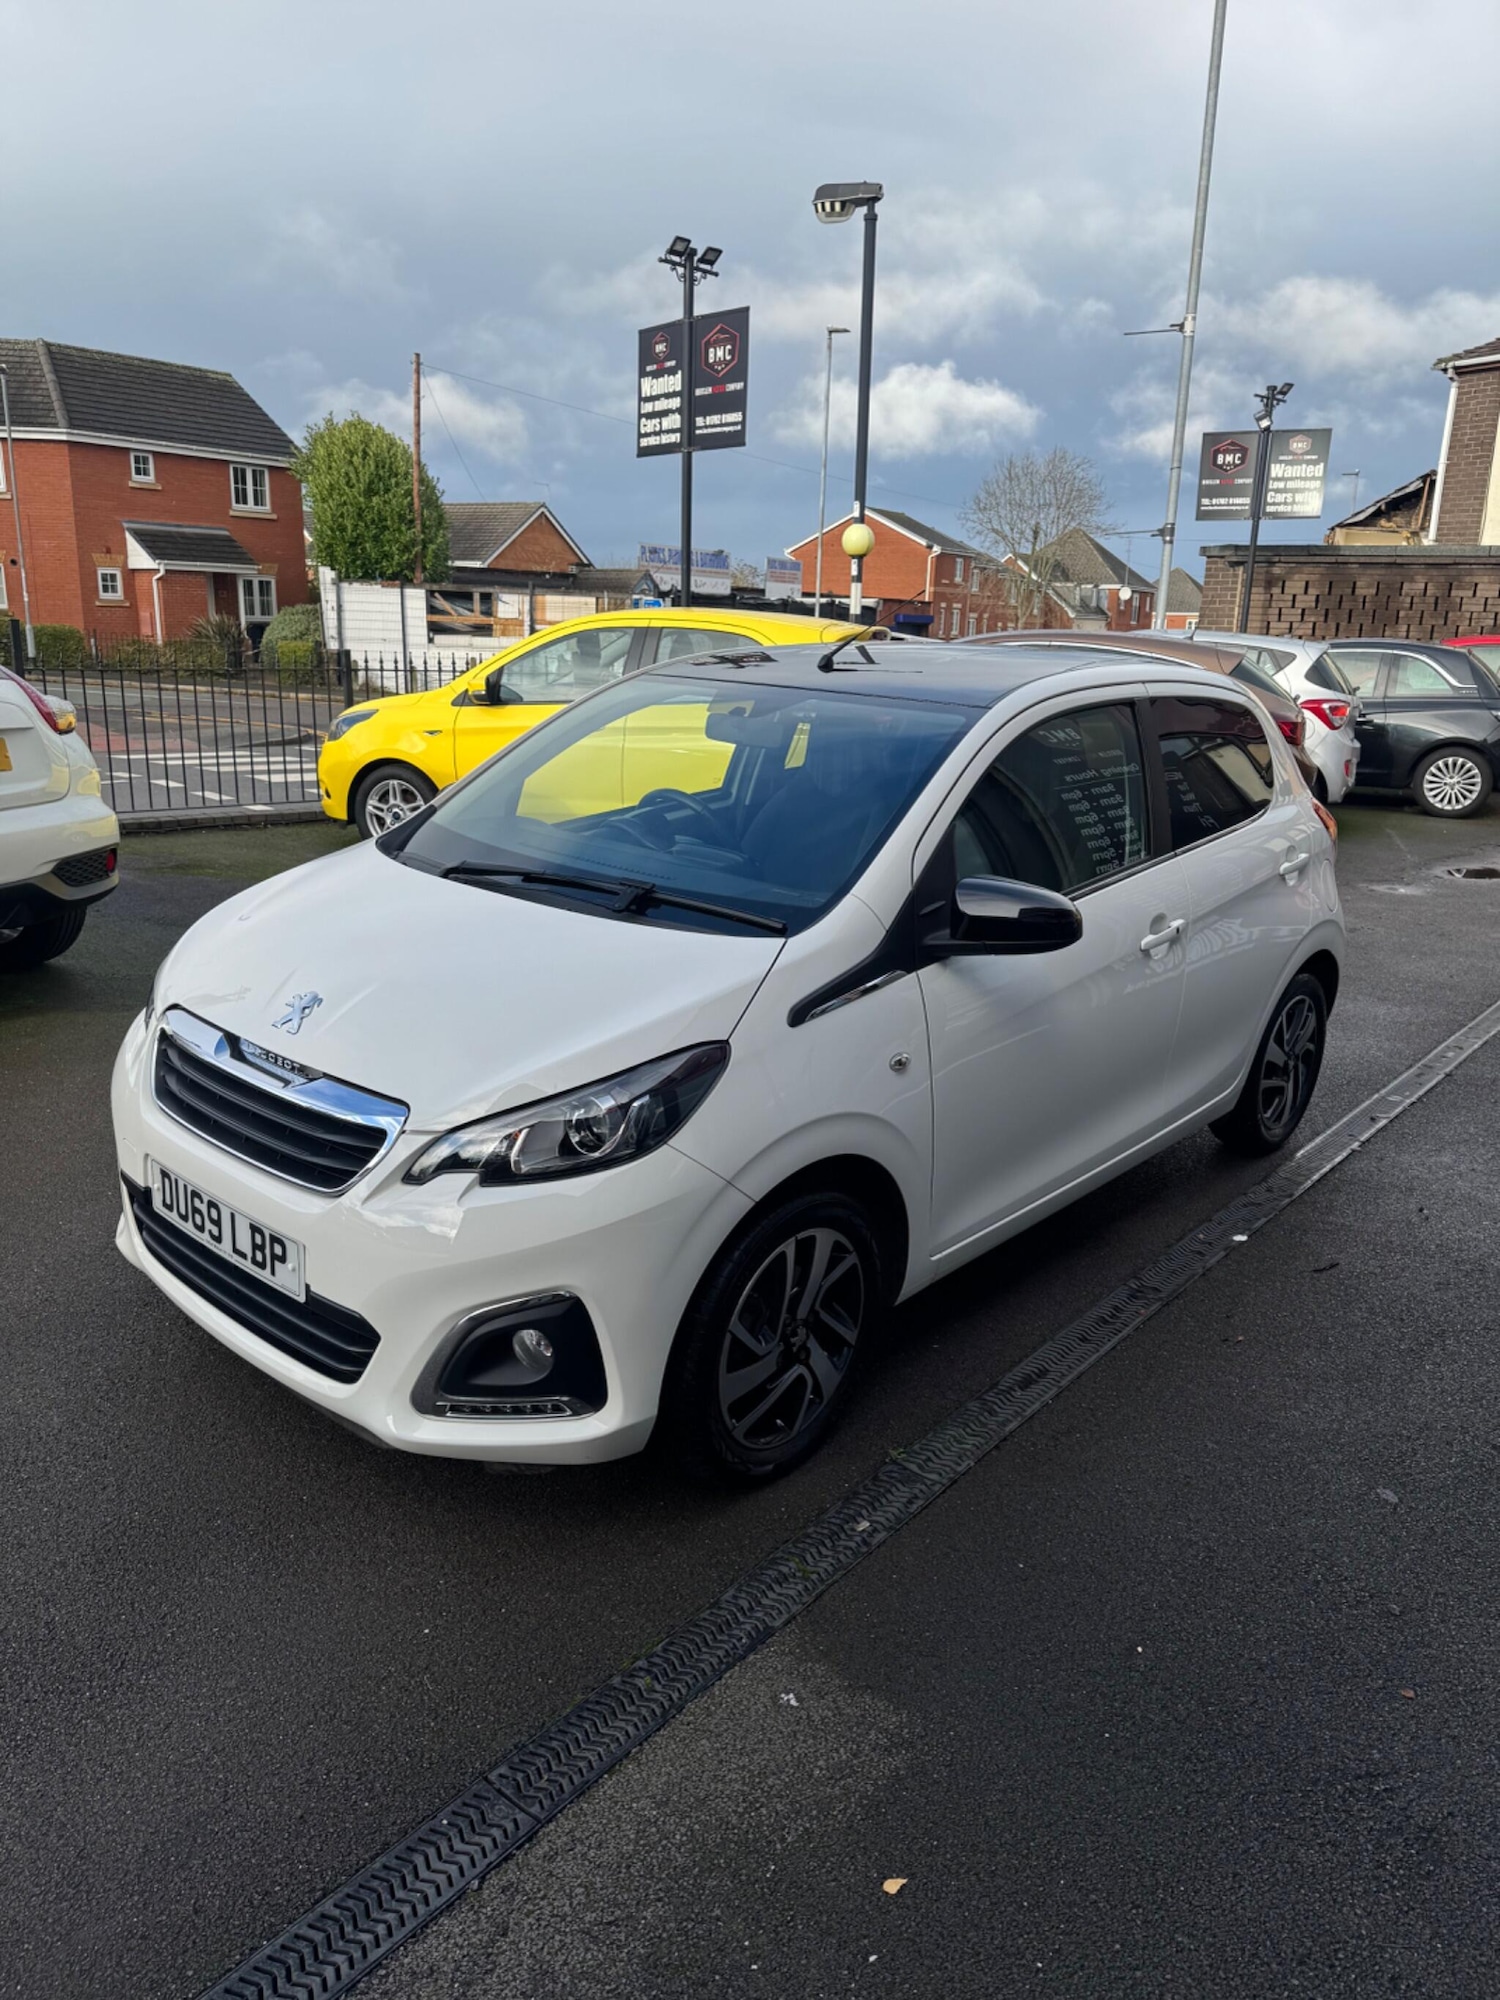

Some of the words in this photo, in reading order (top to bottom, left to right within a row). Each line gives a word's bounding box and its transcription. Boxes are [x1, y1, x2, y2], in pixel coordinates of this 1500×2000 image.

[708, 344, 732, 364] BMC
[640, 370, 682, 398] Wanted
[640, 401, 654, 414] Low
[654, 396, 681, 412] mileage
[640, 416, 660, 434] Cars
[662, 412, 681, 431] with
[640, 434, 660, 447] service
[661, 432, 681, 444] history
[1216, 454, 1242, 465] BMC
[1270, 463, 1324, 478] Wanted
[1268, 480, 1286, 489] Low
[1286, 478, 1321, 489] mileage
[1266, 492, 1293, 503] Cars
[159, 1168, 222, 1244] DU69
[230, 1212, 286, 1277] LBP
